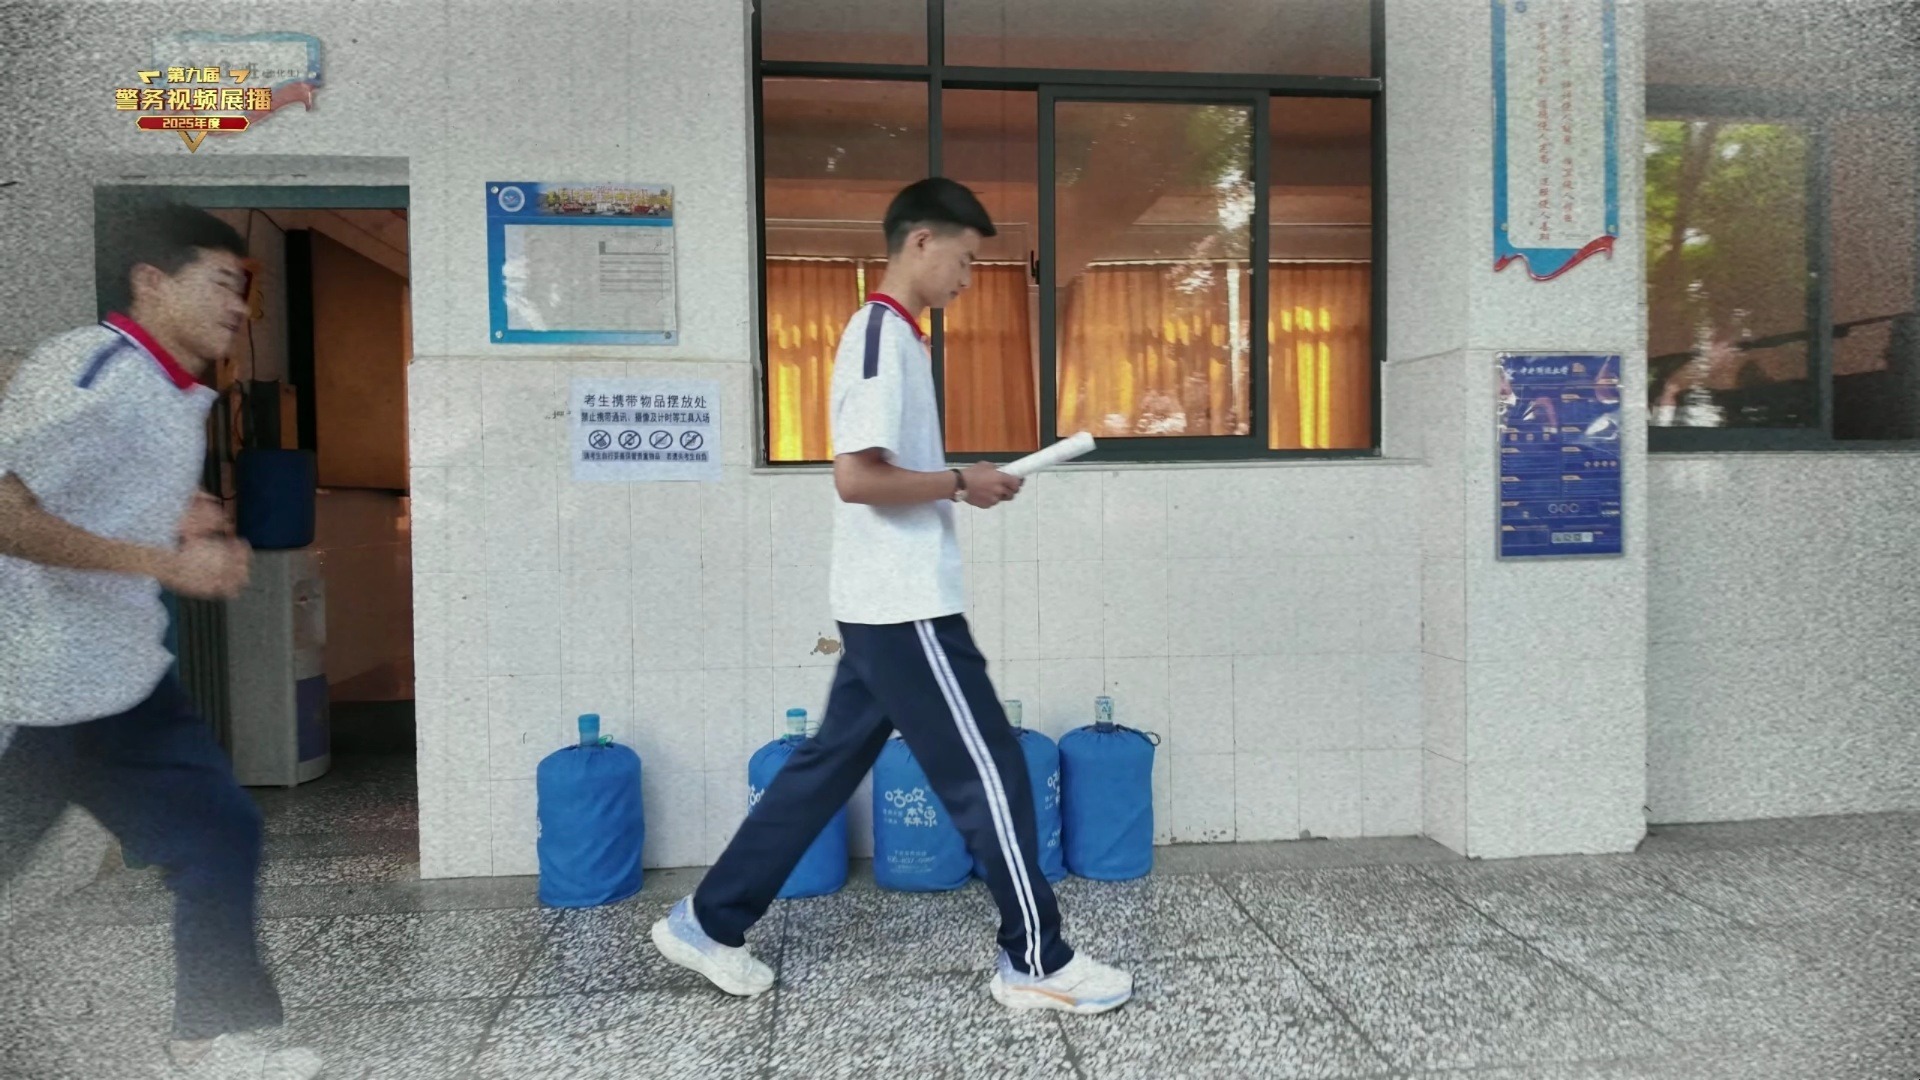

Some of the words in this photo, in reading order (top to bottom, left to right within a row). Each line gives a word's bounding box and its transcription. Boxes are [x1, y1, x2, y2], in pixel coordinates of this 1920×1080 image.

[584, 394, 707, 409] 考生携带物品摆放处
